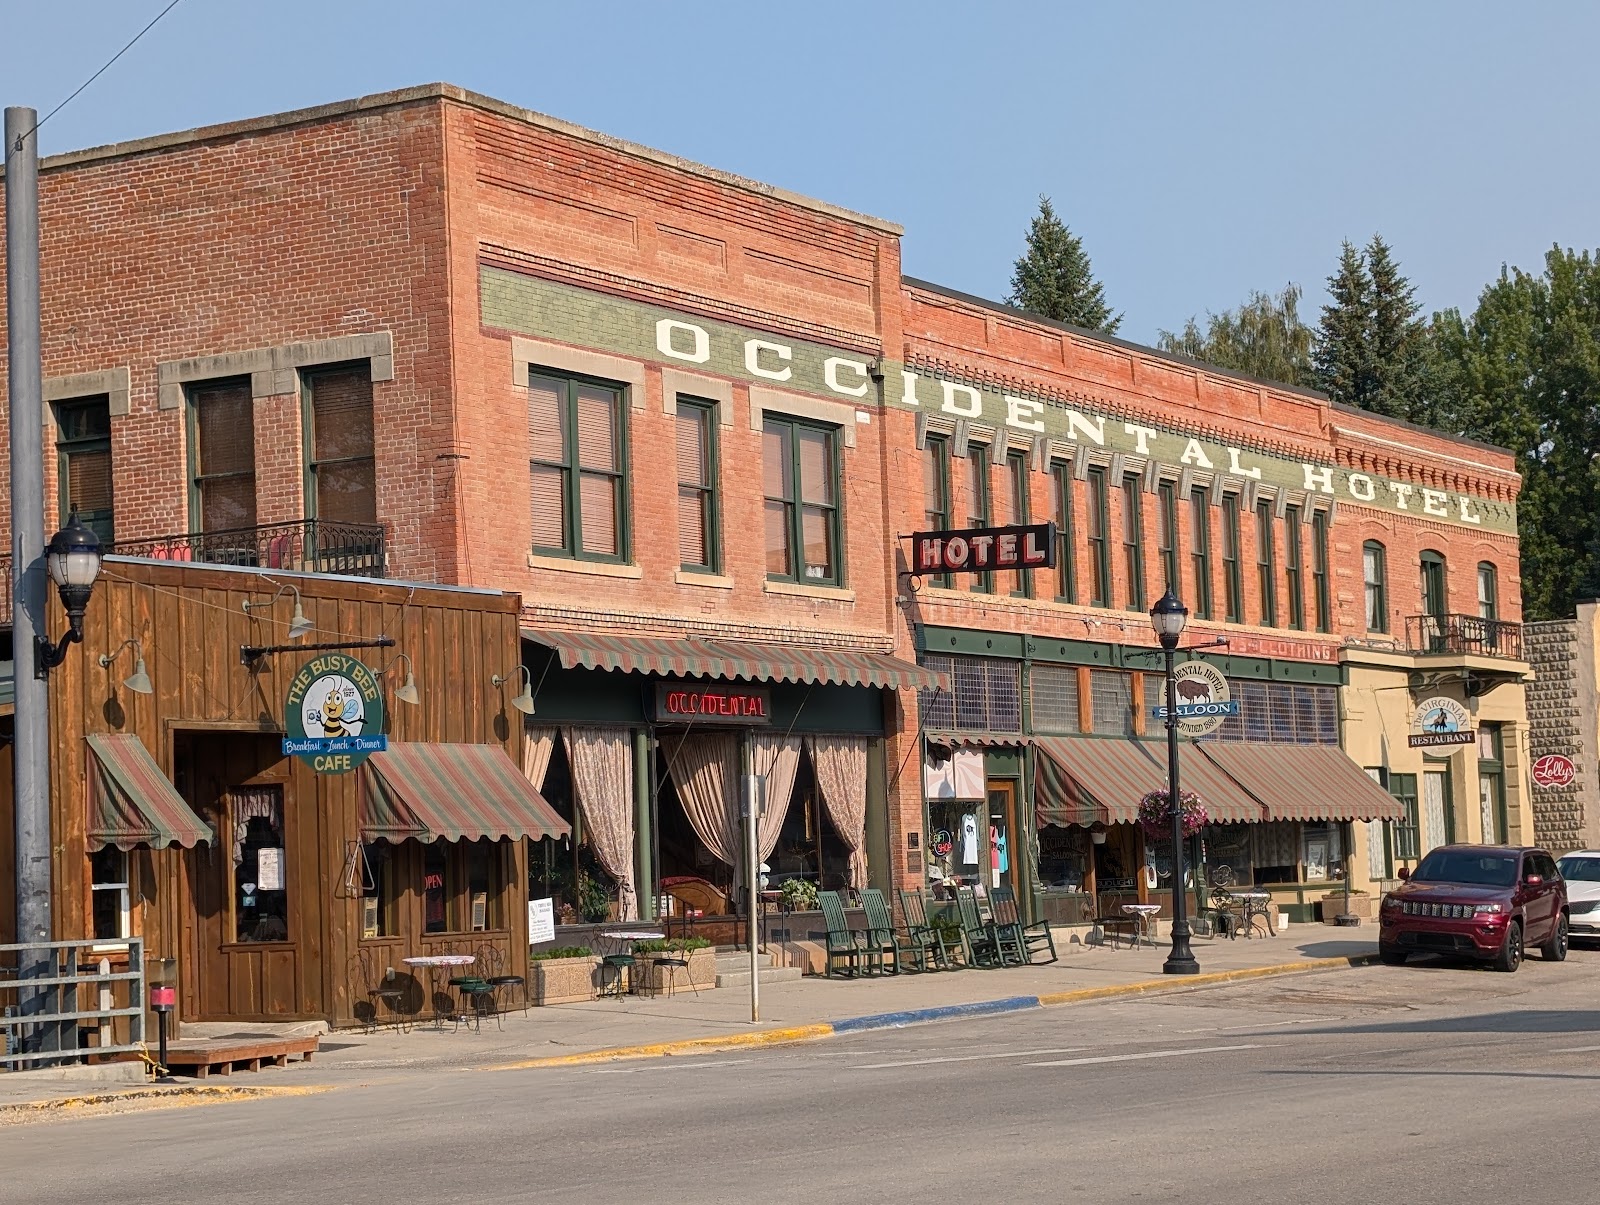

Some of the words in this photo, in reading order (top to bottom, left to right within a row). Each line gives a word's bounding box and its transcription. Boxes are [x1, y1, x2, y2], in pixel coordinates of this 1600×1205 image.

[656, 319, 1261, 479] OCCIDENTAL
[1302, 464, 1480, 524] HOTEL
[920, 533, 1045, 569] HOTEL
[288, 670, 312, 706] THE
[309, 656, 353, 676] BUSY
[351, 665, 377, 703] BEE
[1203, 668, 1223, 693] HOTEL
[668, 693, 766, 716] OCCIDENTAL
[1158, 703, 1231, 717] SALOON
[1413, 713, 1424, 729] The
[1421, 699, 1468, 726] VIRGINIAN
[285, 741, 321, 753] Breakfast
[326, 741, 350, 752] Lunch
[355, 738, 381, 749] Dinner
[1411, 733, 1472, 745] RESTAURANT
[314, 755, 351, 771] CAFE
